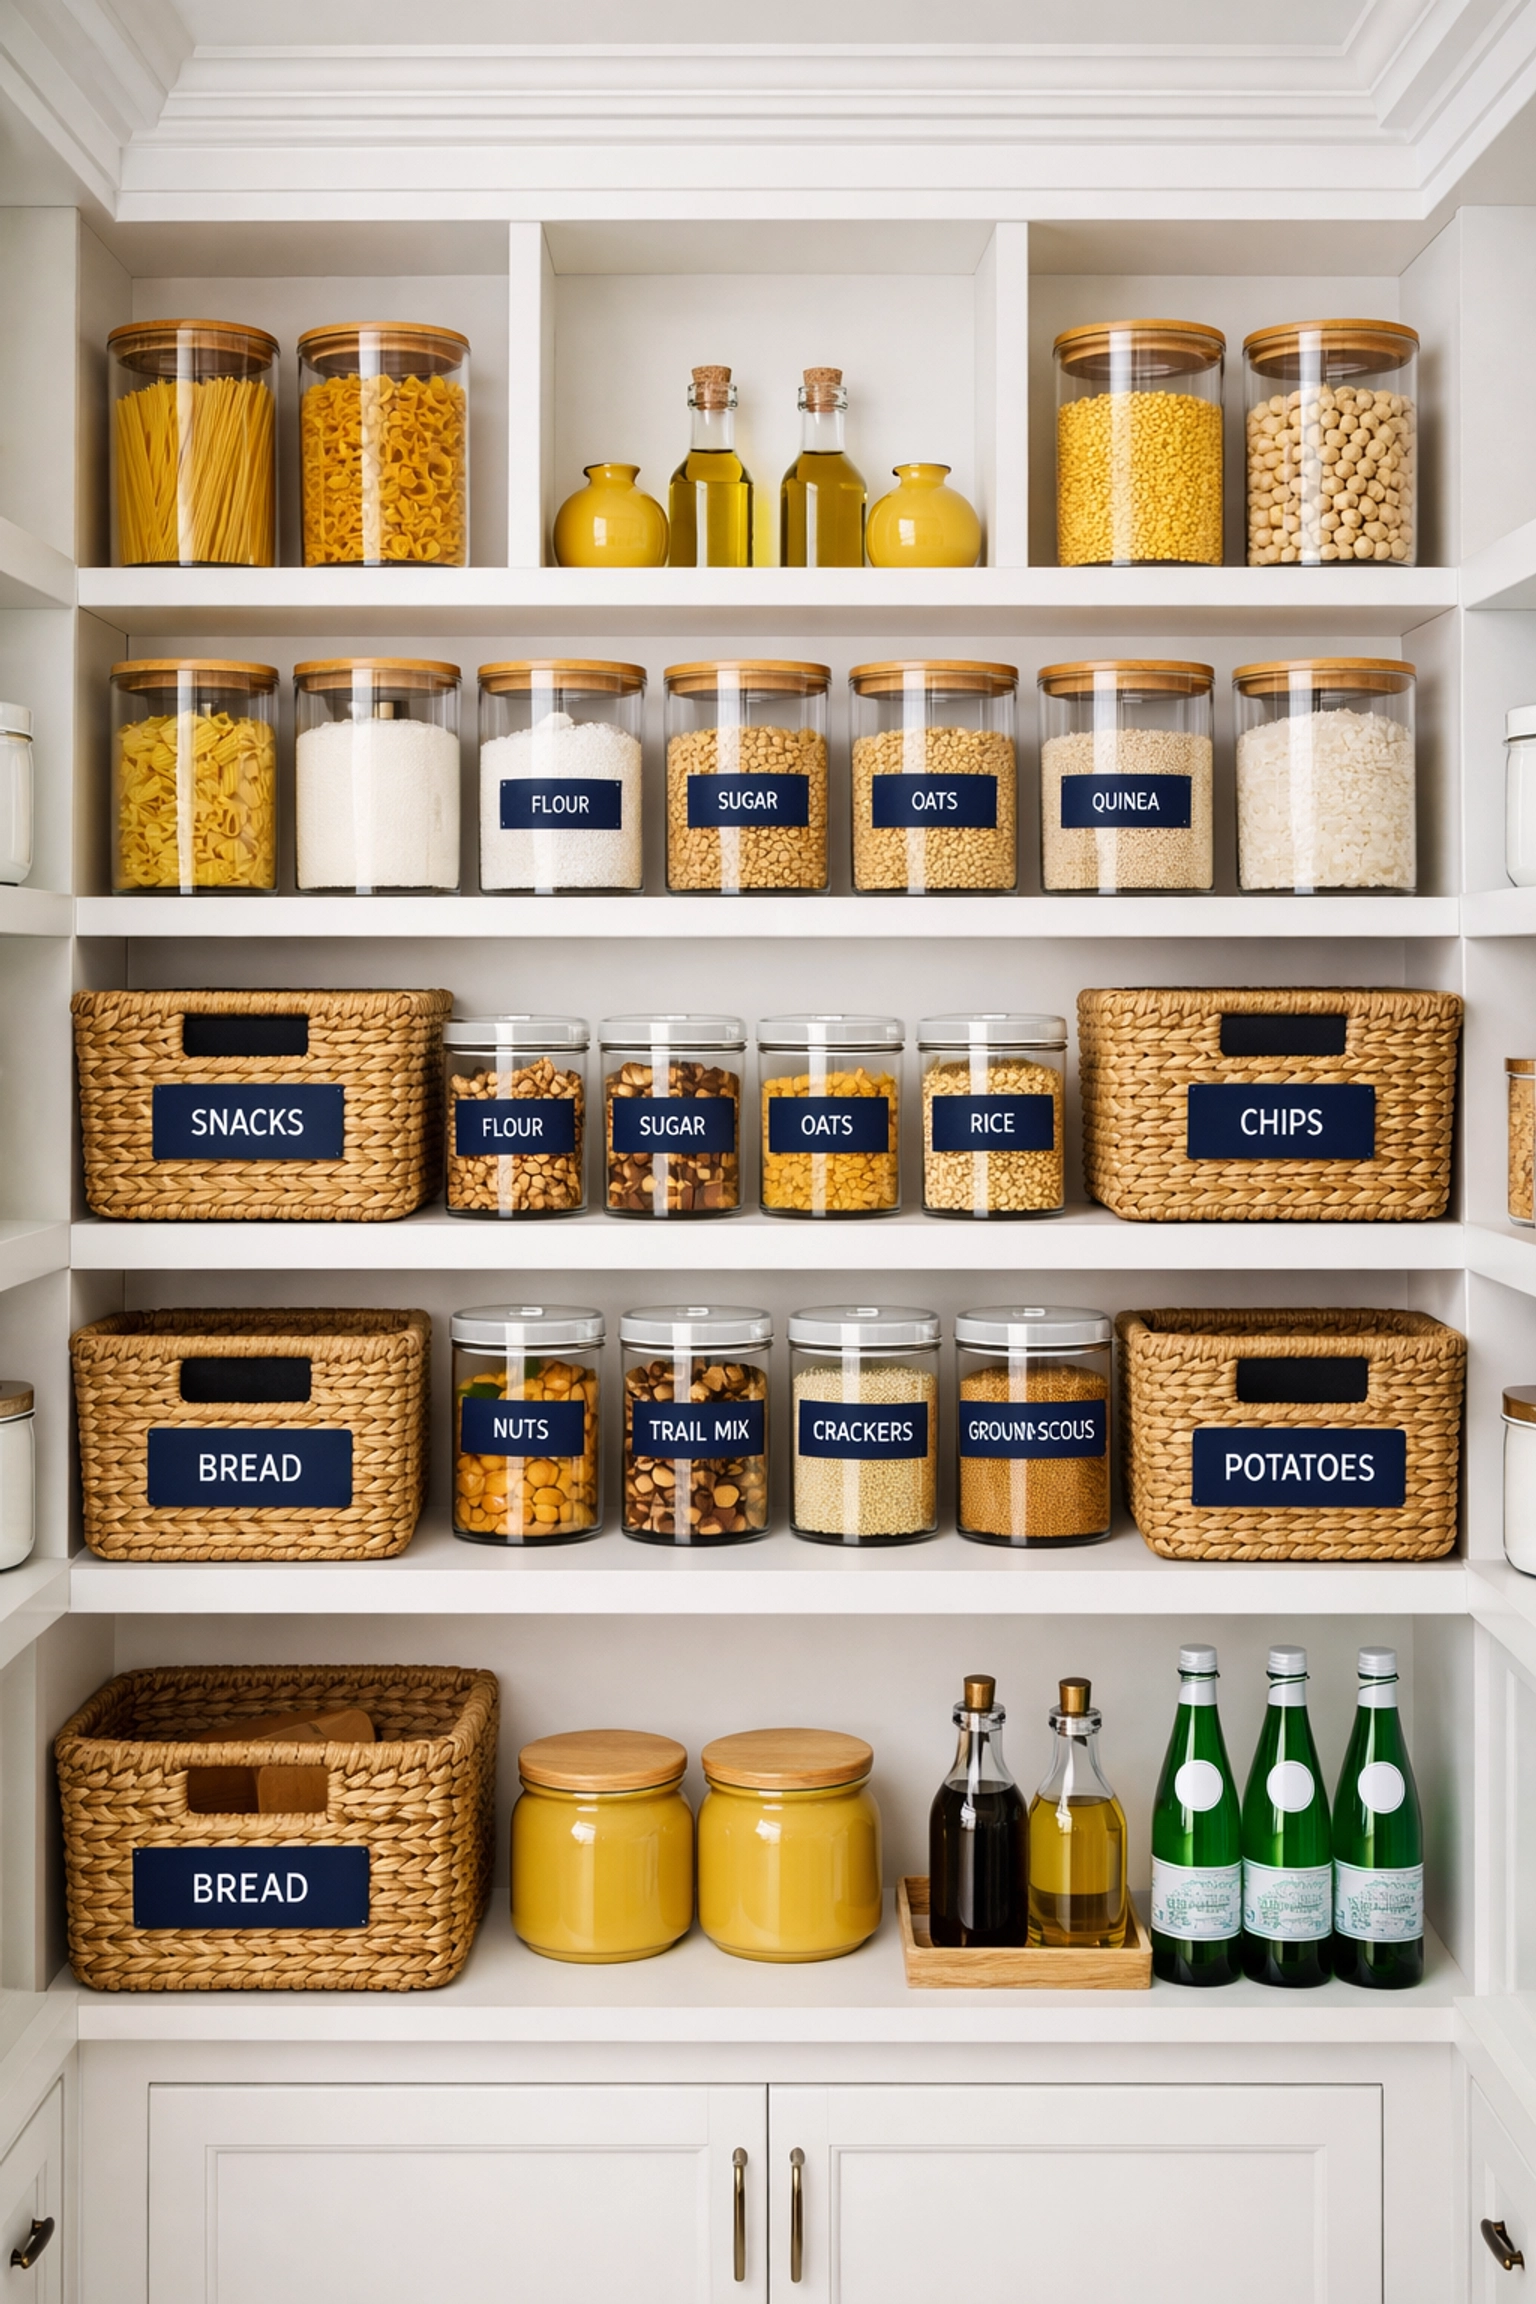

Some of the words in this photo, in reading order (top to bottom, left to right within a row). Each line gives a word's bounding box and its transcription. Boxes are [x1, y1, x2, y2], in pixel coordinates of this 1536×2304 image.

[531, 795, 590, 814] FLOUR
[717, 791, 778, 810] SUGAR
[911, 791, 958, 811] OATS
[1092, 791, 1160, 813] QUINEA
[191, 1108, 304, 1137] SNACKS
[482, 1117, 543, 1138] FLOUR
[639, 1115, 706, 1136] SUGAR
[800, 1114, 853, 1136] OATS
[970, 1112, 1015, 1134] RICE
[1240, 1108, 1323, 1136] CHIPS
[493, 1417, 549, 1440] NUTS
[649, 1419, 707, 1442] TRAIL
[714, 1419, 750, 1442] MIX
[813, 1420, 913, 1443] CRACKERS
[198, 1453, 302, 1482] BREAD
[1225, 1453, 1375, 1482] POTATOES
[192, 1872, 309, 1904] BREAD
